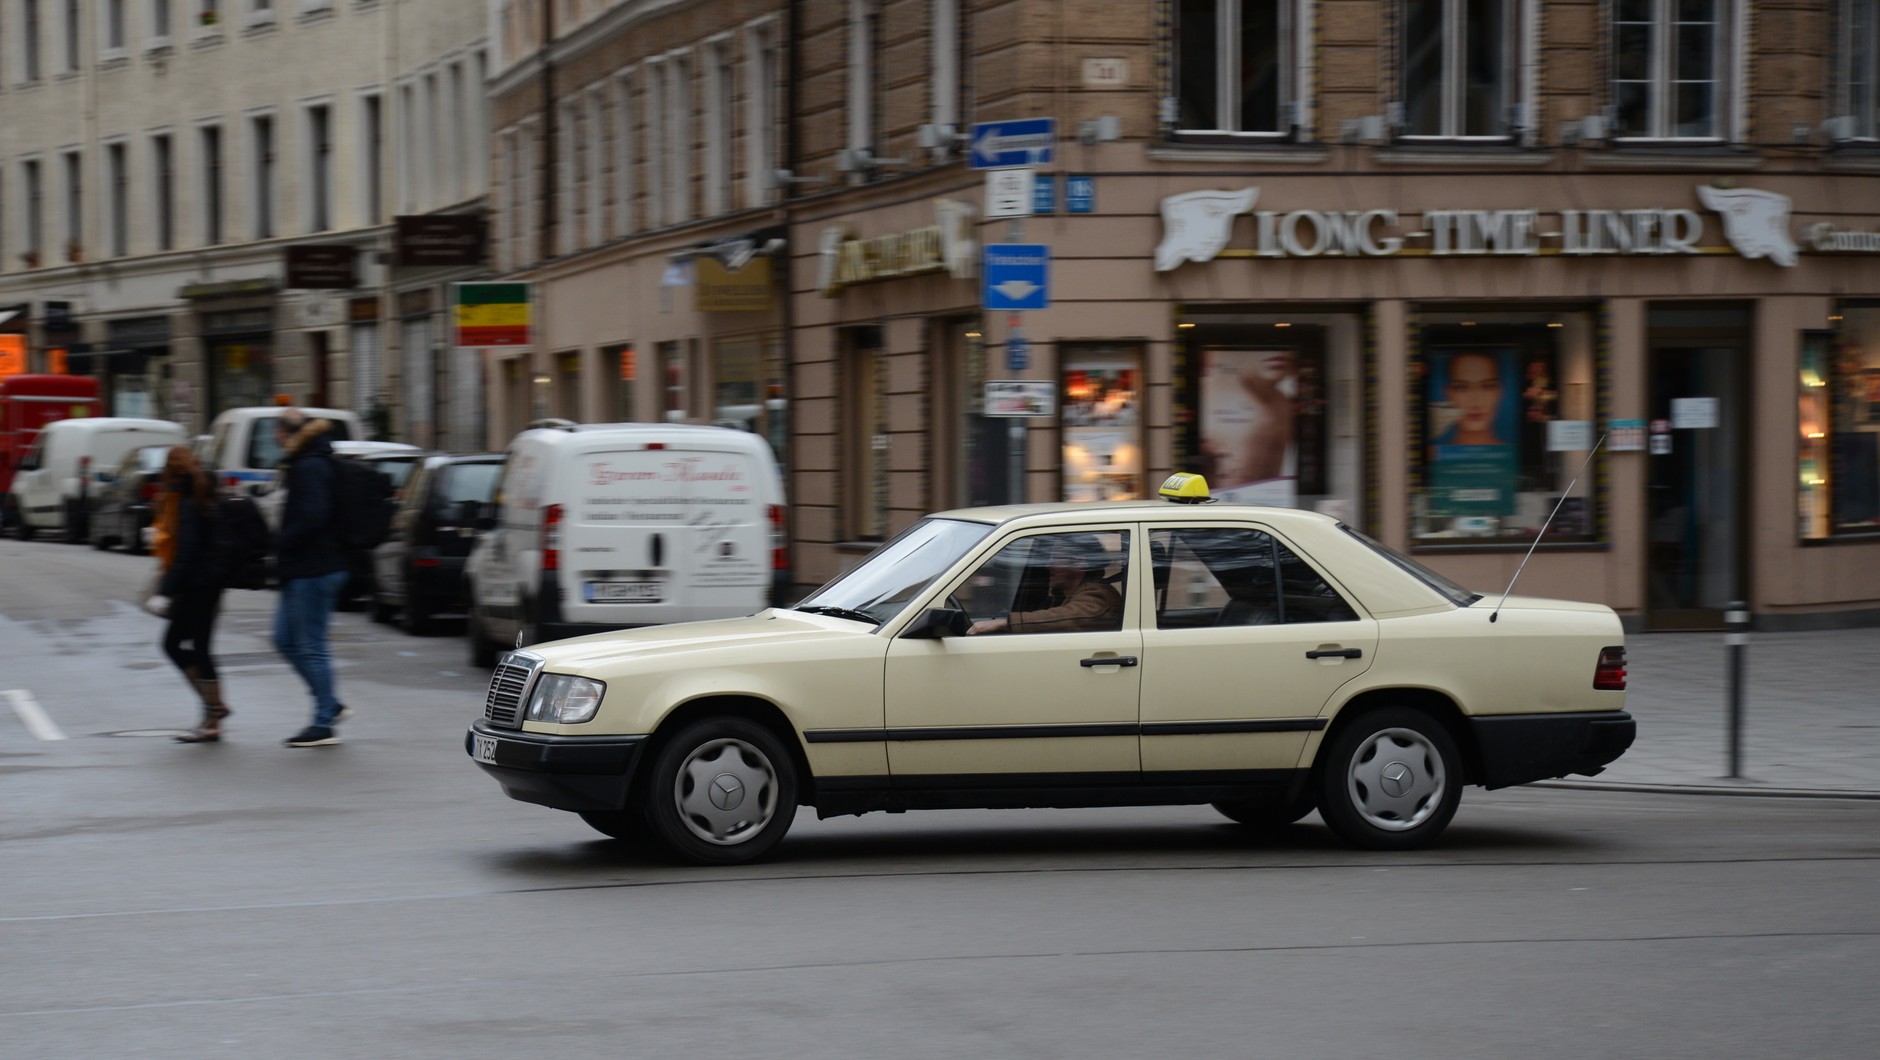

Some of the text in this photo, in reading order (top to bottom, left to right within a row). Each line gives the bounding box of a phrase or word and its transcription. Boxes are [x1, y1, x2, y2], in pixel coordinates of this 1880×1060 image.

[1255, 209, 1704, 257] LONG-TIME-LINER
[1162, 476, 1190, 490] TAXI
[483, 739, 496, 761] 252
